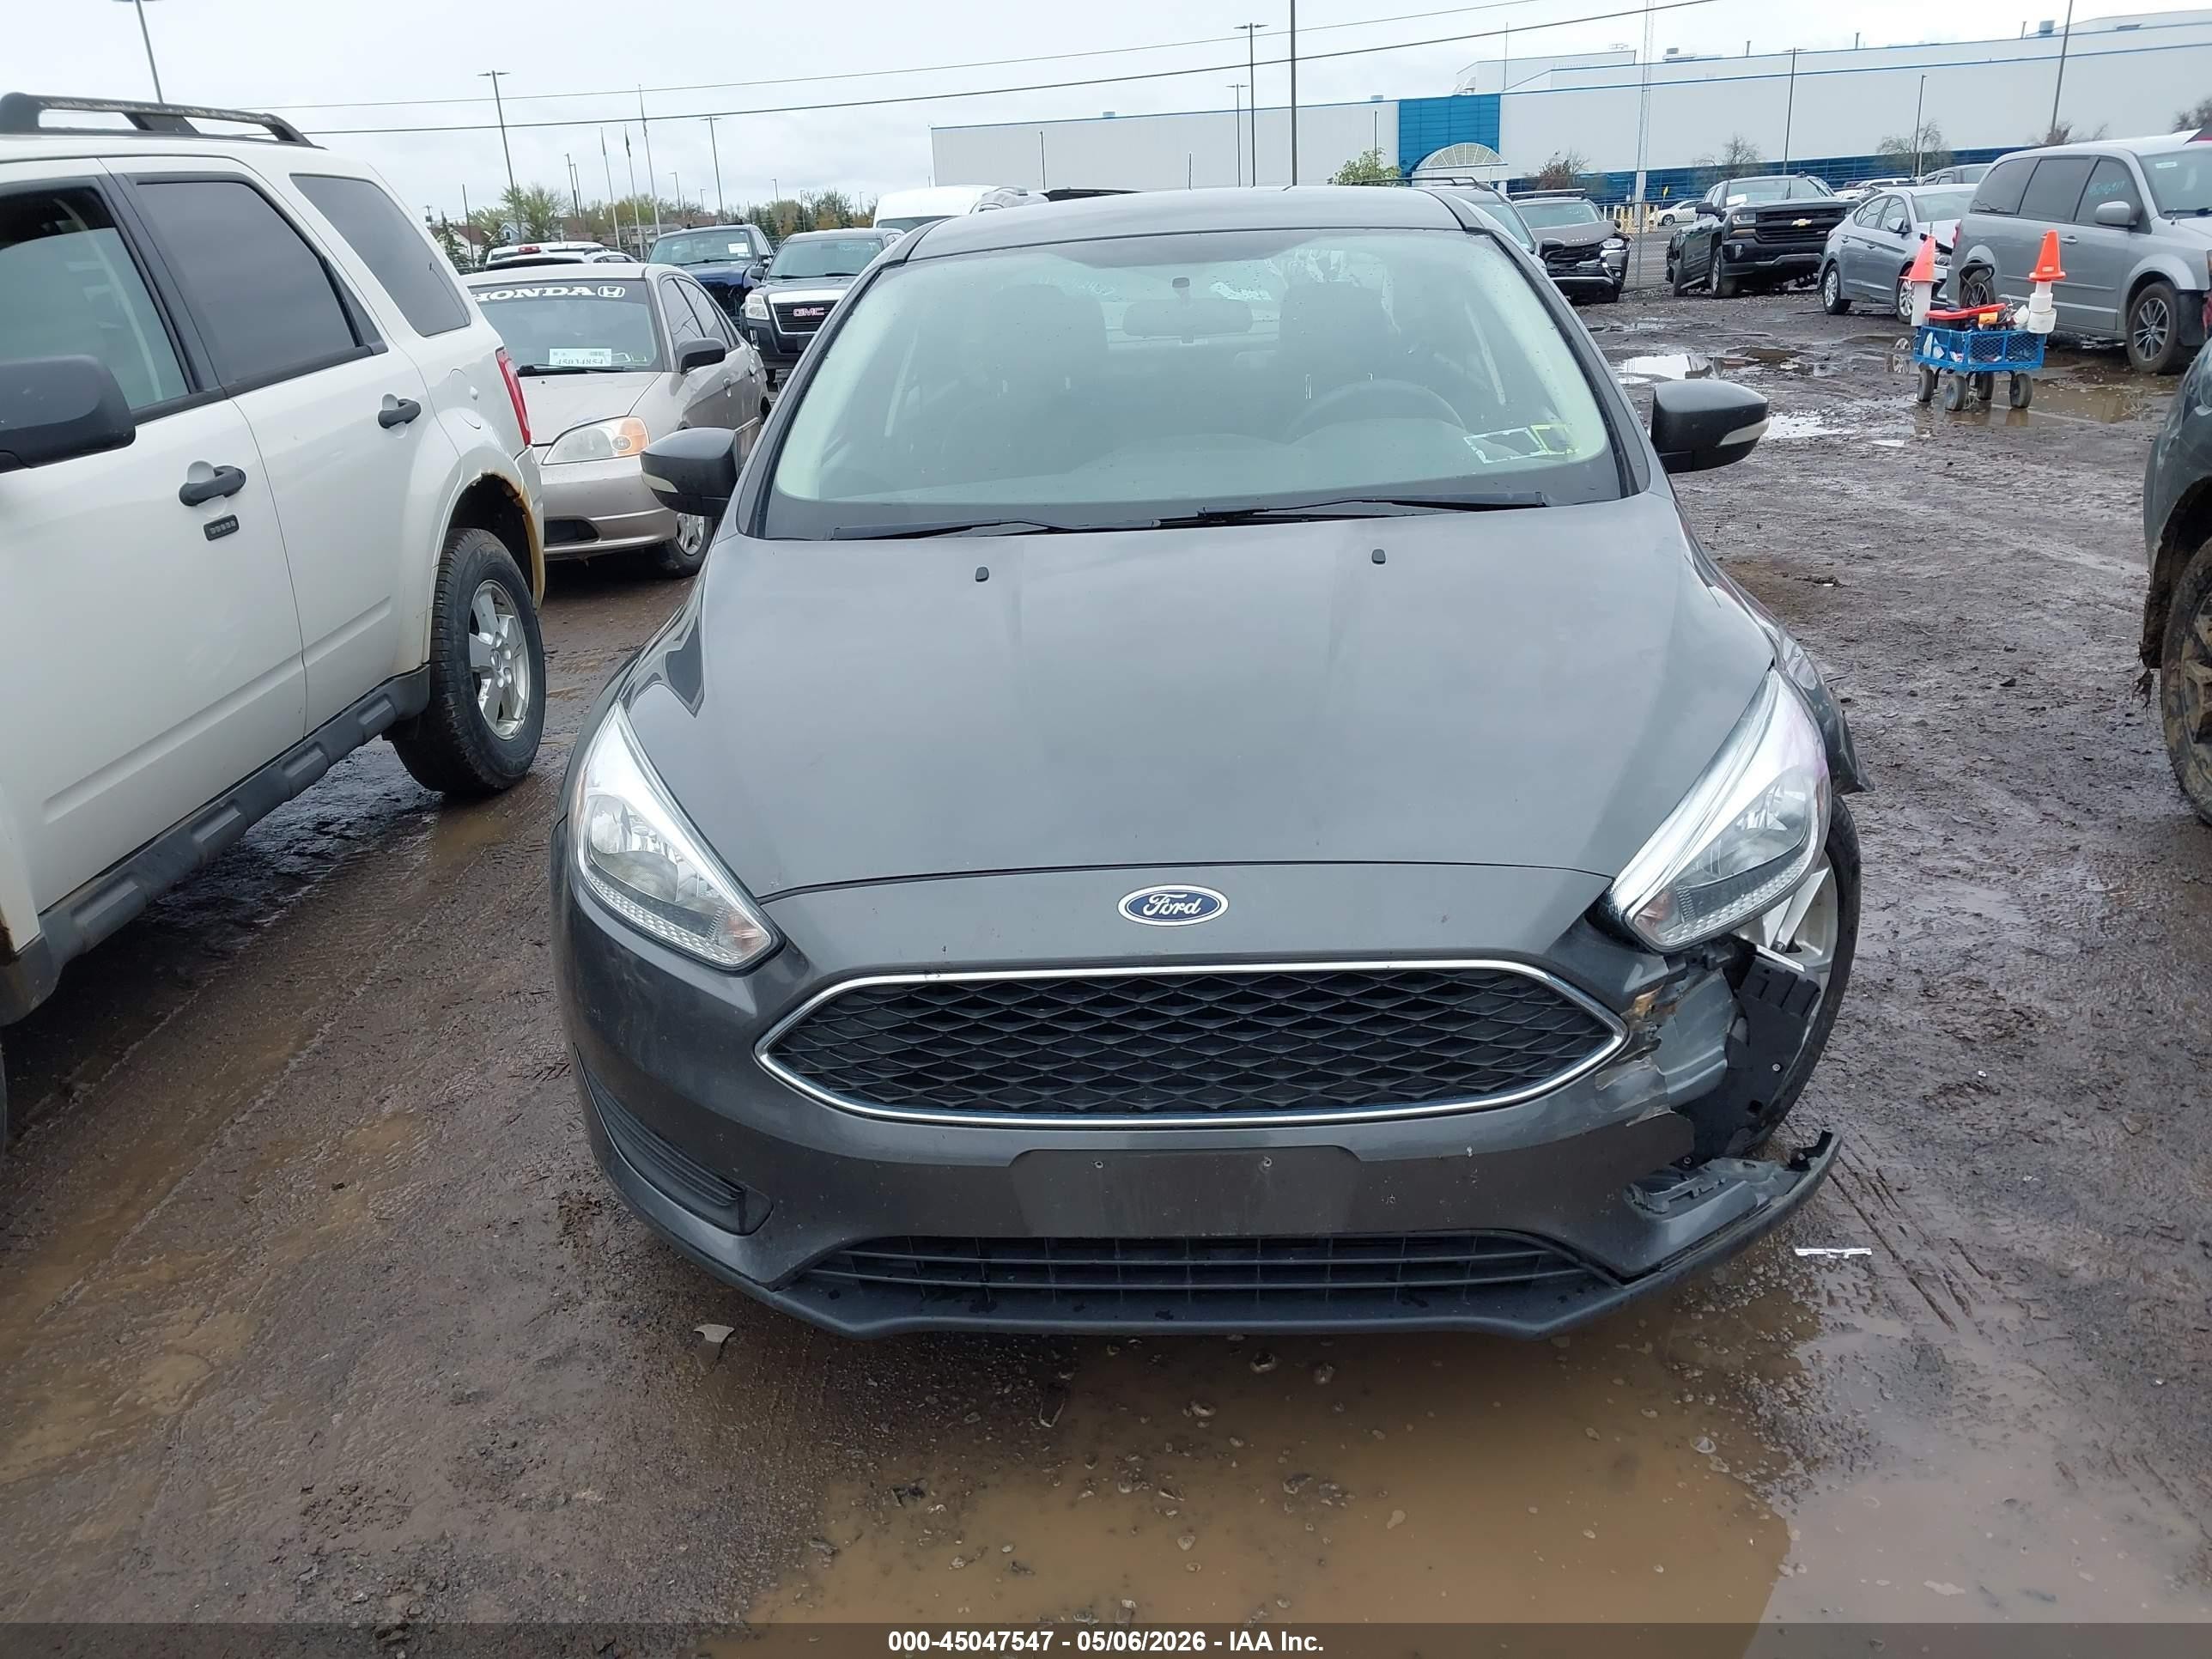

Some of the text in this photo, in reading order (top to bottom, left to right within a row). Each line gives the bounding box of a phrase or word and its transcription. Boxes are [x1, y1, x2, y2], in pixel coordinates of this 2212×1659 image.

[471, 286, 595, 301] HONDA
[793, 307, 824, 317] GMC
[1143, 894, 1202, 915] Ford
